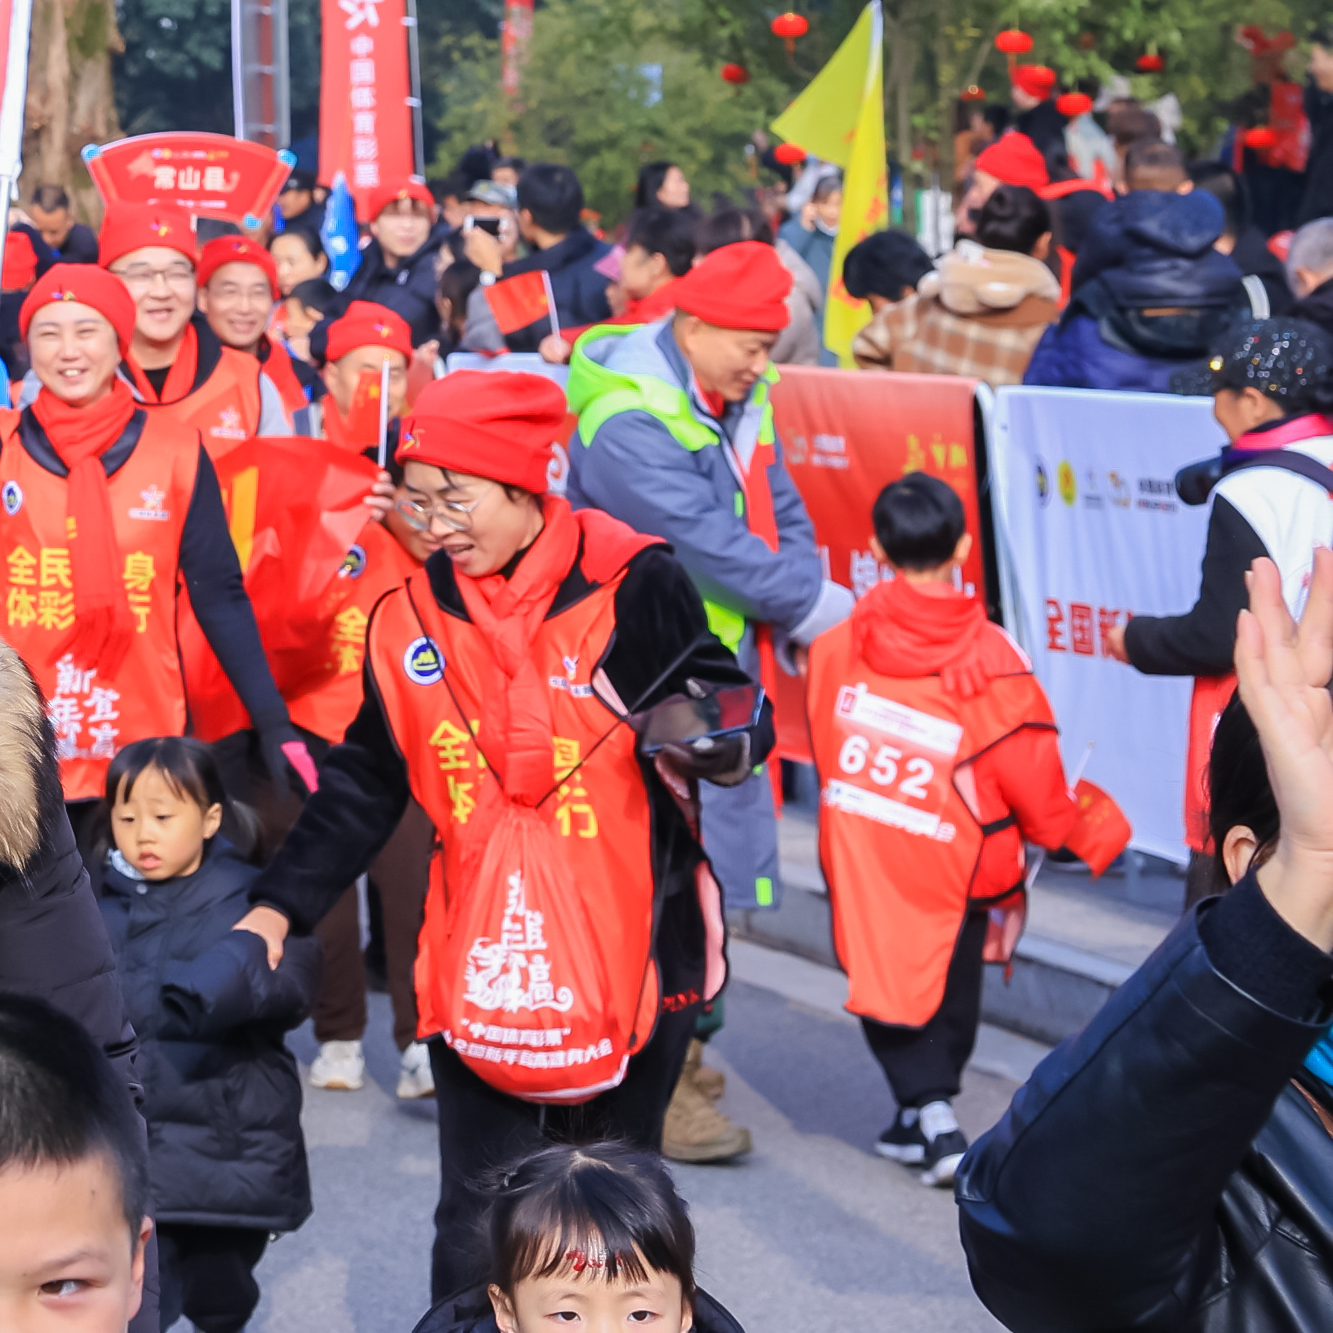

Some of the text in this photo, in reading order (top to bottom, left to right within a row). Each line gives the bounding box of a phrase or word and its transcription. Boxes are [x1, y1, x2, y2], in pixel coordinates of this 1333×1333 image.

[6, 545, 157, 591] 全民身
[838, 734, 935, 800] 652
